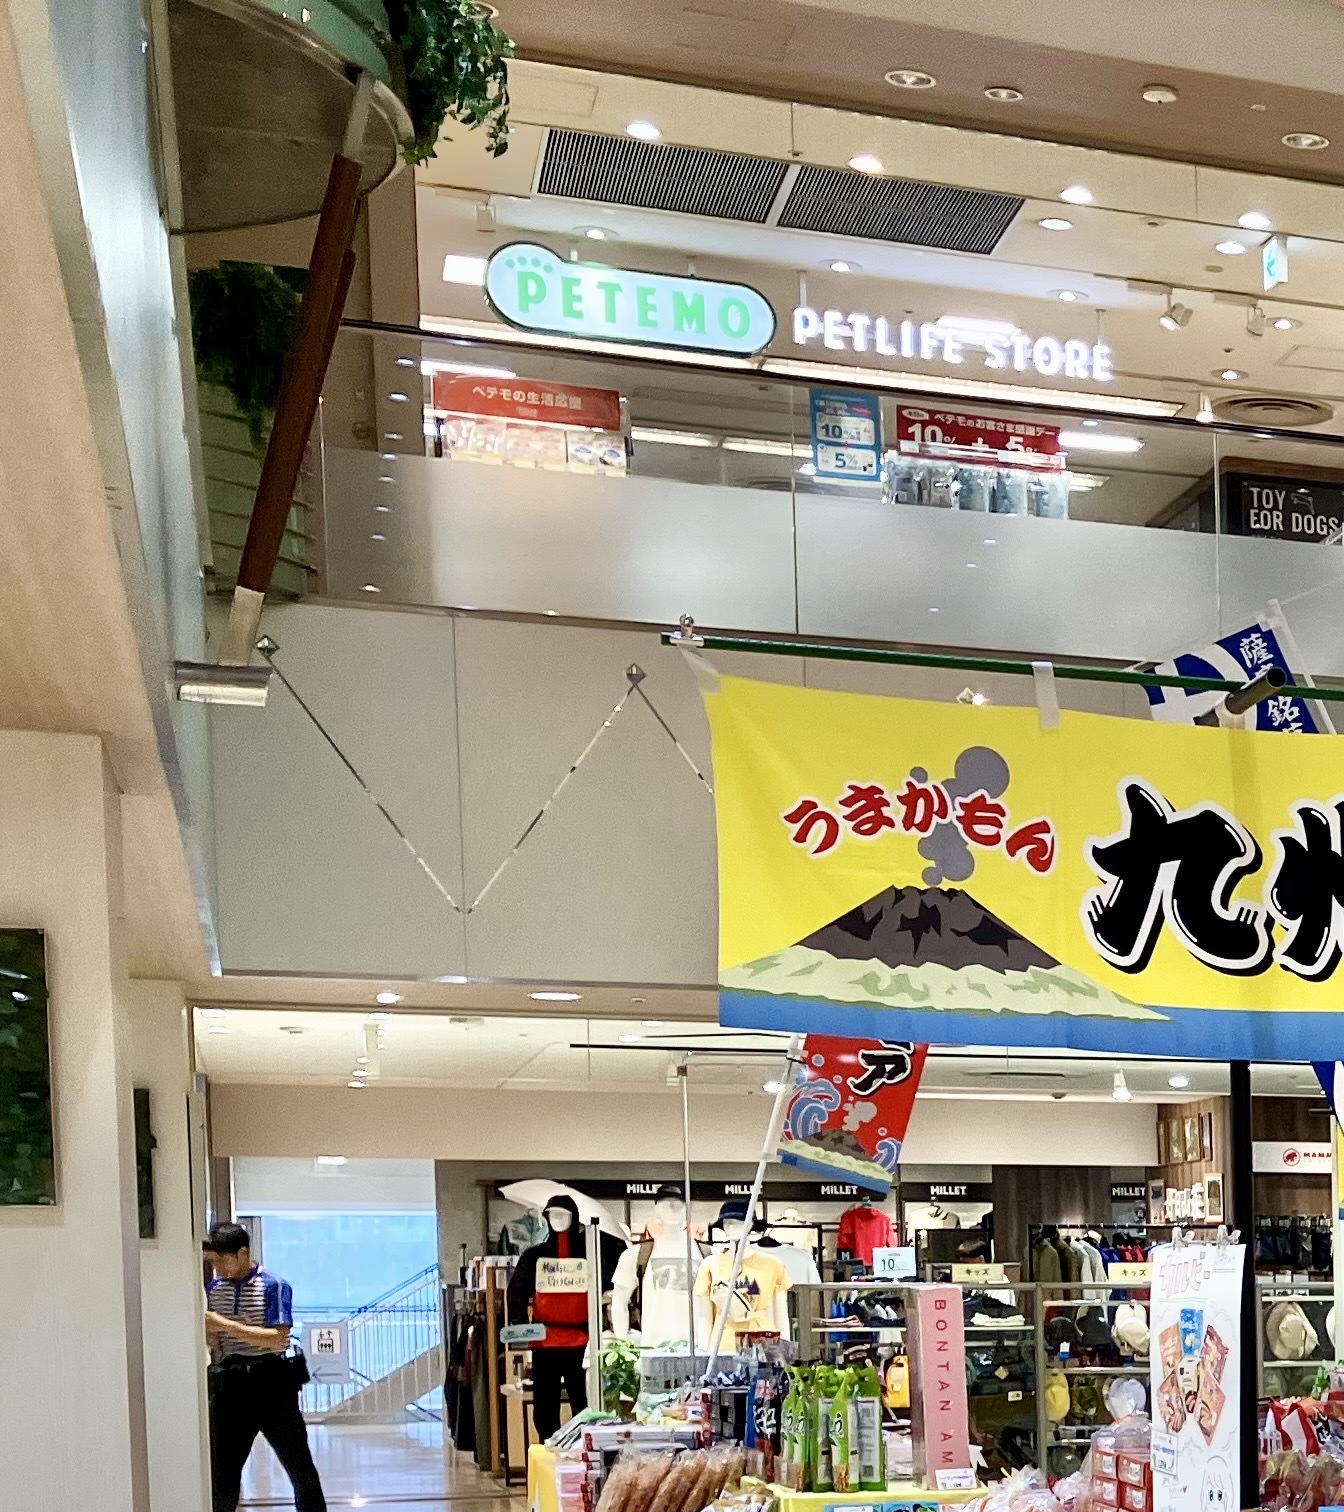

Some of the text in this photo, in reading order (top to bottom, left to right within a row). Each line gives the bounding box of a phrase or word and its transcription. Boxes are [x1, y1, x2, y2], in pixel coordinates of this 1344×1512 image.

[516, 269, 751, 340] PETEMO
[793, 306, 1114, 383] PETLIFE STORE
[1249, 486, 1286, 511] TOY
[1290, 512, 1339, 537] DOGS
[783, 774, 1058, 876] うまかもん
[820, 1185, 858, 1196] MILLET
[929, 1185, 968, 1197] MILLET
[1111, 1186, 1146, 1198] MILLET
[963, 1268, 990, 1277] キッズ
[1121, 1268, 1147, 1277] キッズ
[934, 1298, 953, 1413] BONTAN
